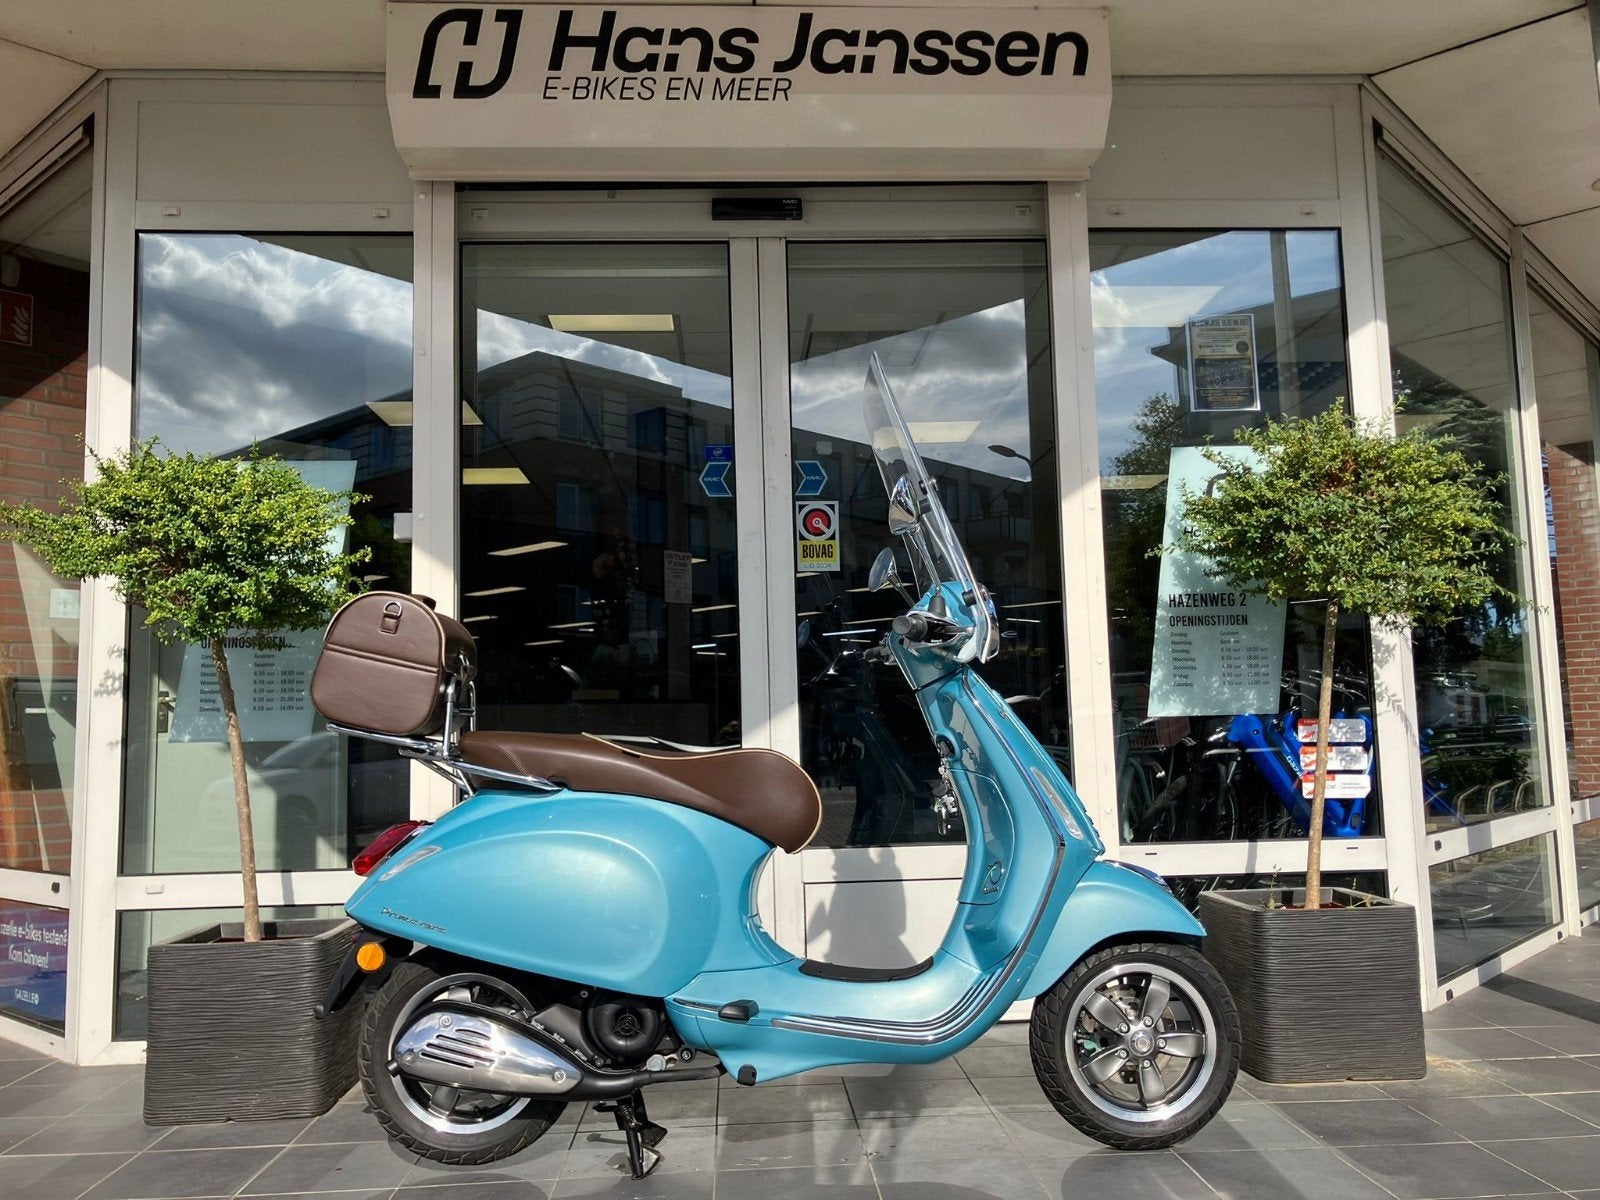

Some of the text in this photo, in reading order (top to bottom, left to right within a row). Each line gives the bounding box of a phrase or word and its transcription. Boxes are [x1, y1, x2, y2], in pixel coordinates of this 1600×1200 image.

[548, 10, 1089, 76] Hans Janssen
[544, 78, 792, 102] E-BIKES EN MEER
[802, 544, 833, 559] BOVAG
[1169, 593, 1246, 607] HAZENWEG 2
[1170, 615, 1248, 626] OPENINGSTIJDEN
[18, 922, 41, 942] e-bikes
[43, 928, 67, 946] testen?
[8, 944, 48, 968] Kom binnen!
